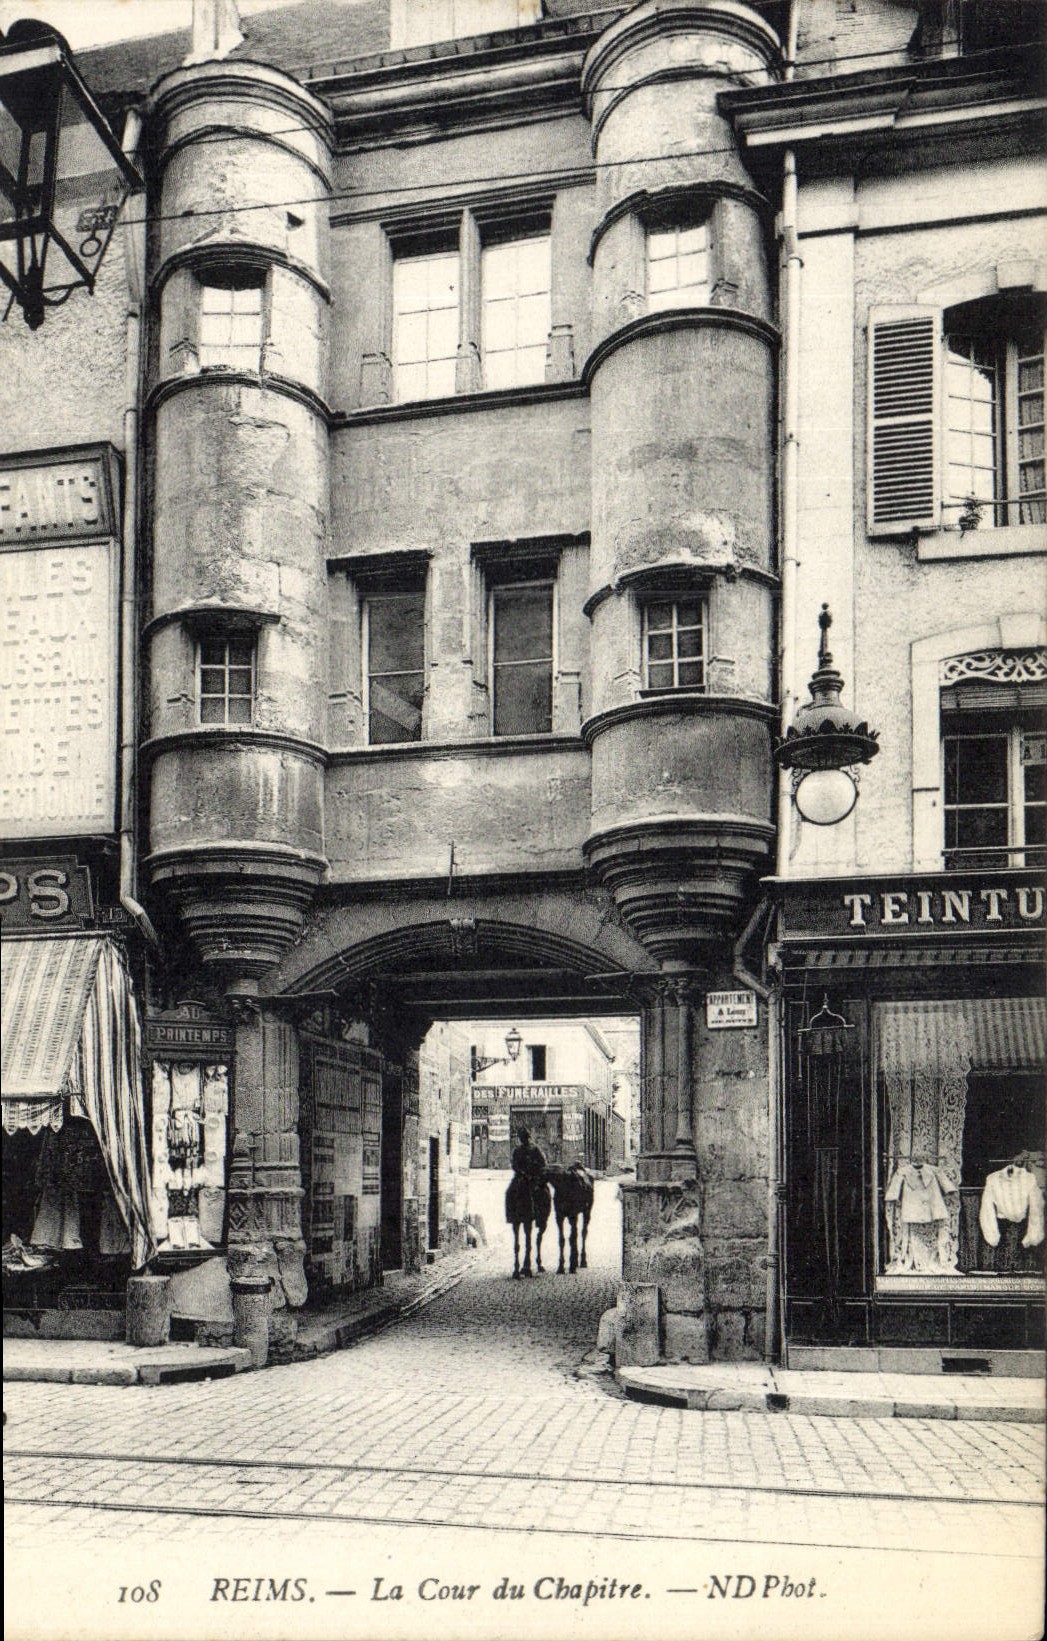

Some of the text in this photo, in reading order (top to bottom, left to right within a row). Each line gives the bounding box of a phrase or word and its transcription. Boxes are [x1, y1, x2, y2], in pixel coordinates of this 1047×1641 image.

[843, 887, 1046, 926] TEINTU
[176, 1006, 201, 1020] AU
[156, 1027, 228, 1042] PRINTEMPS
[473, 1089, 495, 1099] DES
